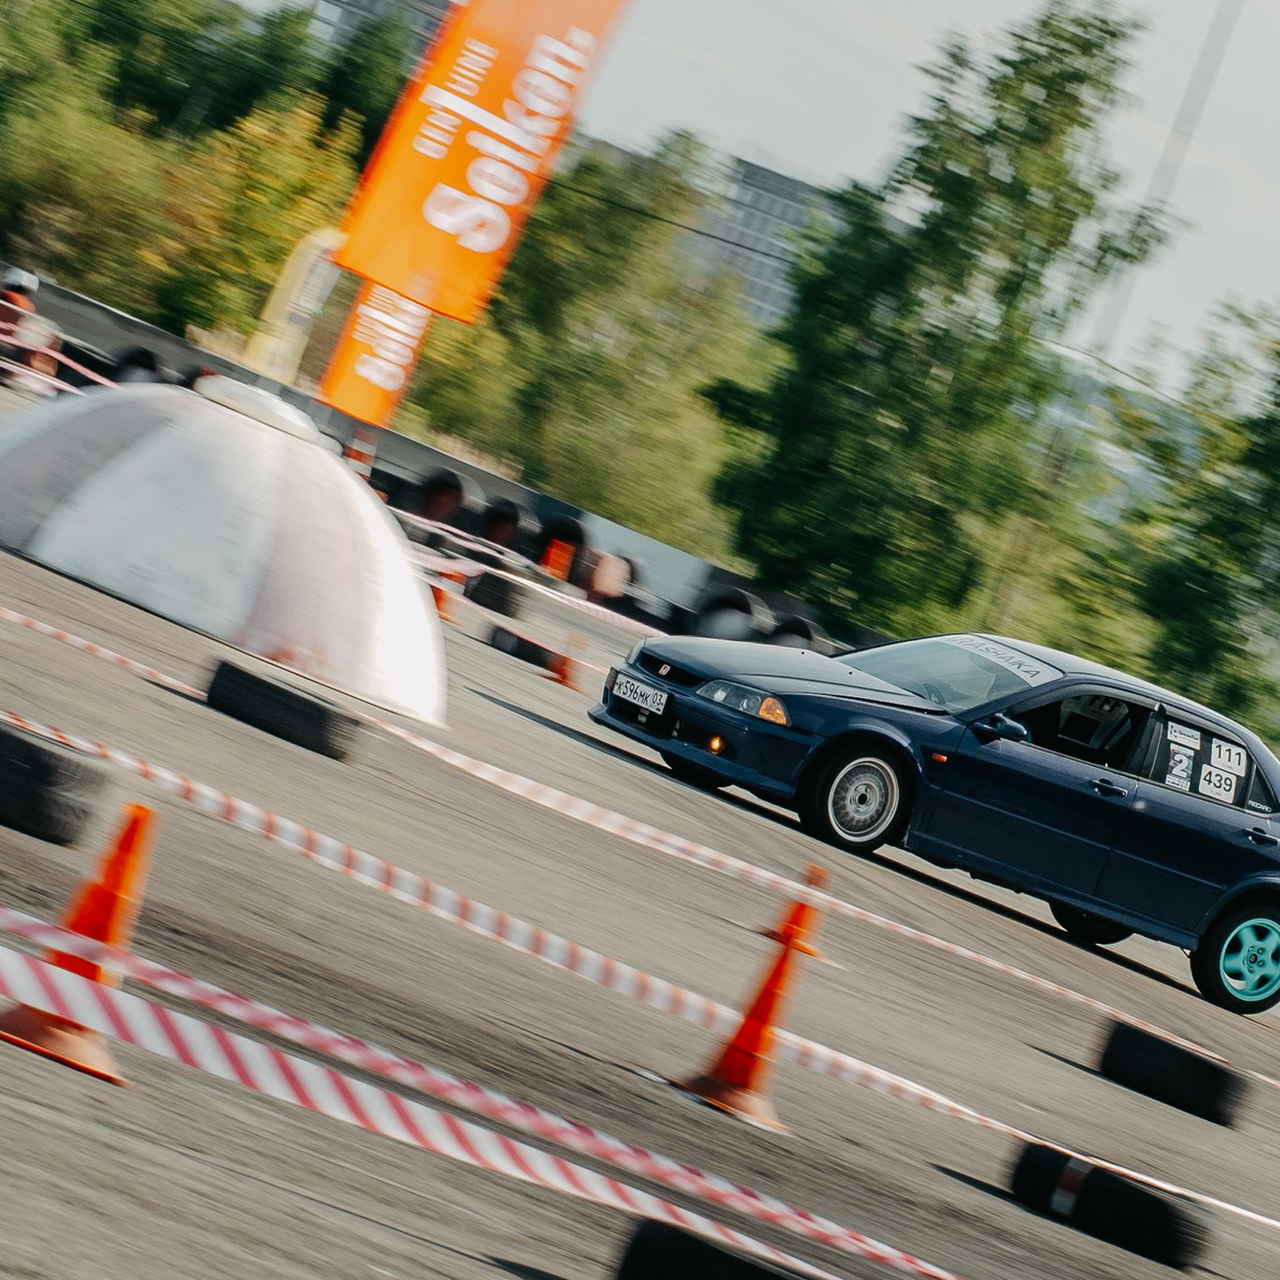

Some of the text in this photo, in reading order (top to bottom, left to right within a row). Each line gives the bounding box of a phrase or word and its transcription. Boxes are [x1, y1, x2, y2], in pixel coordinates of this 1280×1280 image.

[1171, 754, 1189, 778] 2
[1215, 744, 1242, 766] 111
[1203, 770, 1233, 792] 439
[1248, 800, 1272, 812] RECARO
